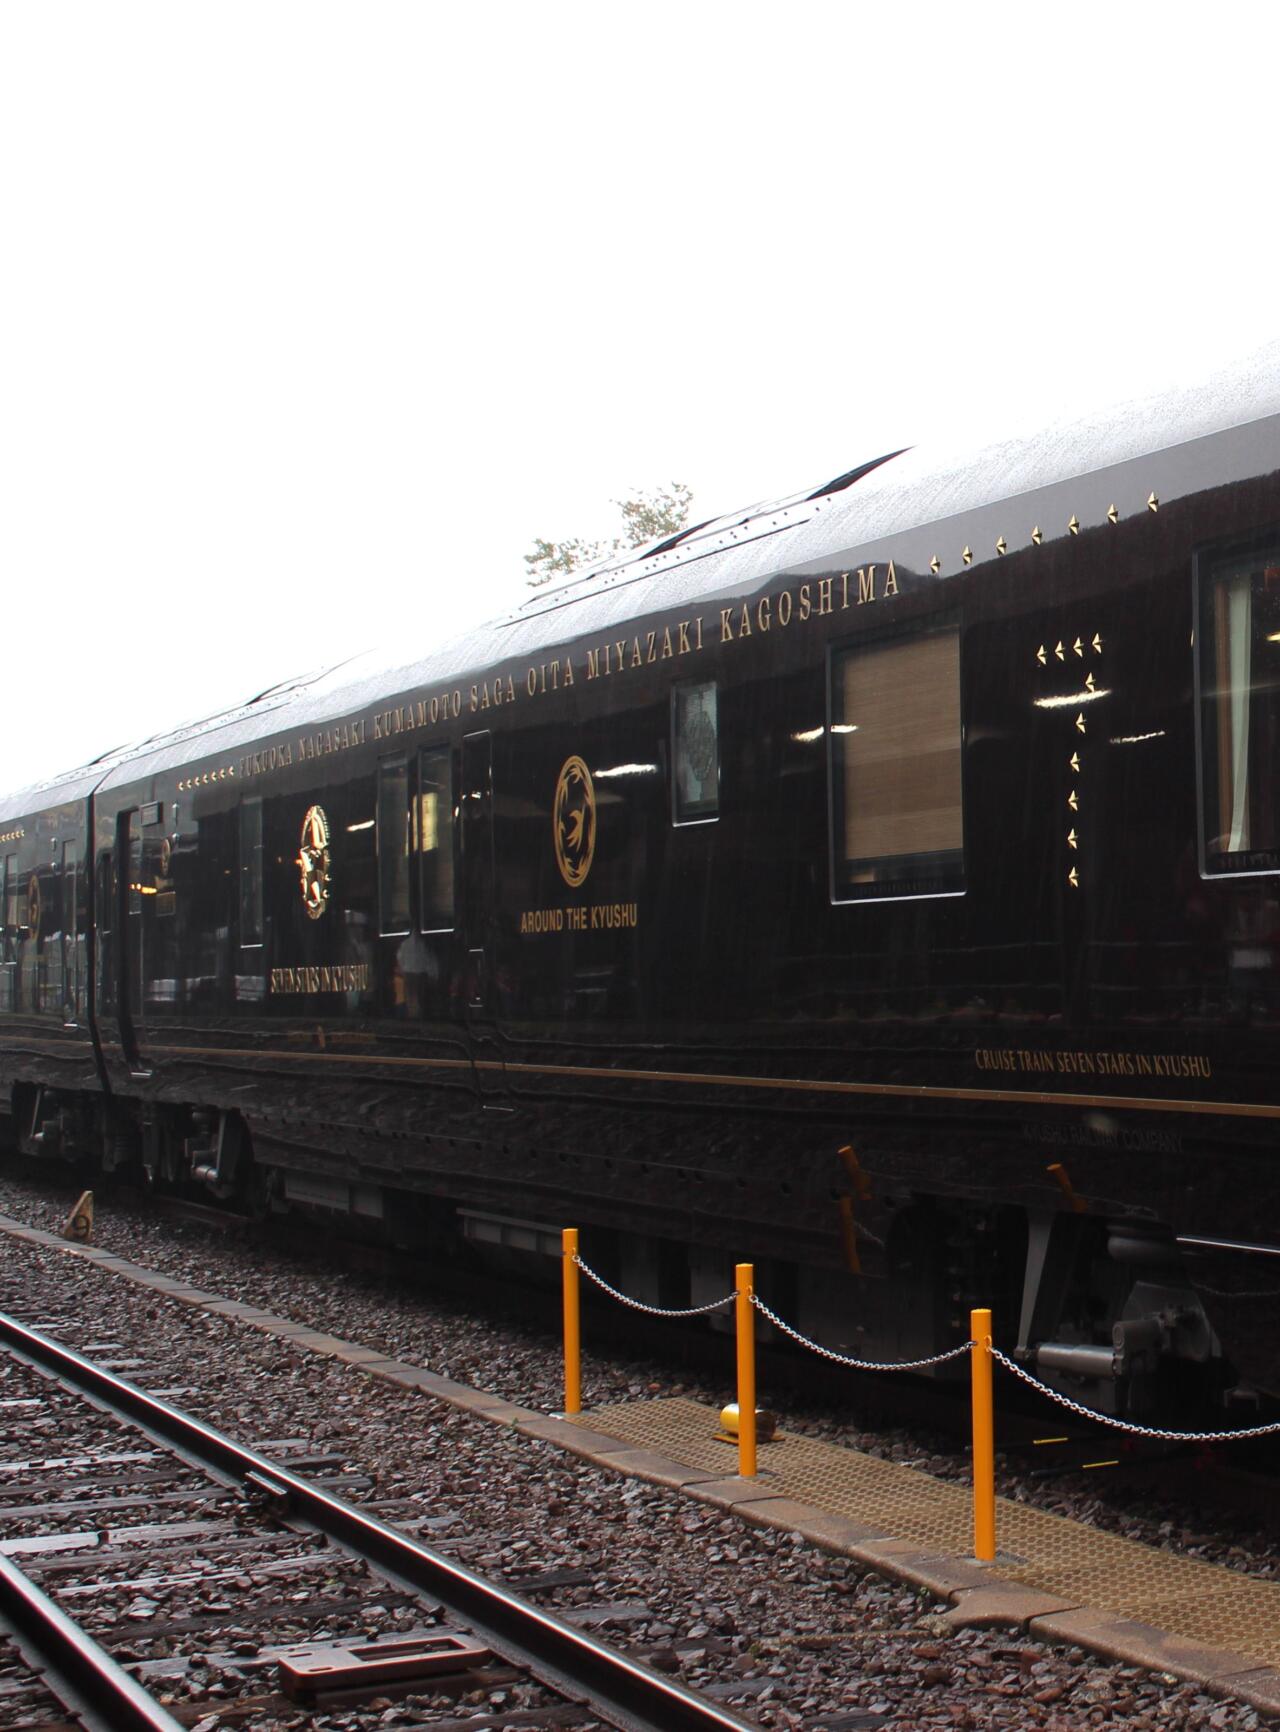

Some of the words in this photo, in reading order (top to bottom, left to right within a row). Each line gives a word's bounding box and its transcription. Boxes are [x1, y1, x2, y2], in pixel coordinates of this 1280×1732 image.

[239, 744, 292, 778] FUKUOKA
[299, 719, 366, 761] NAGASAKI
[374, 690, 461, 739] KUMAMOTO
[470, 674, 515, 713] SAGA
[527, 656, 574, 697] OITA
[587, 617, 703, 680] MIYAZAKI
[720, 560, 899, 642] KAGOSHIMA
[520, 909, 563, 933] AROUND
[566, 907, 587, 930] THE
[591, 903, 638, 928] KYUSHU
[975, 1048, 1016, 1070] CRUISE
[1017, 1050, 1055, 1071] TRAIN
[1056, 1051, 1095, 1073] SEVEN
[1096, 1053, 1134, 1075] STARS
[1136, 1054, 1152, 1074] IN
[1153, 1055, 1212, 1078] KYUSHU
